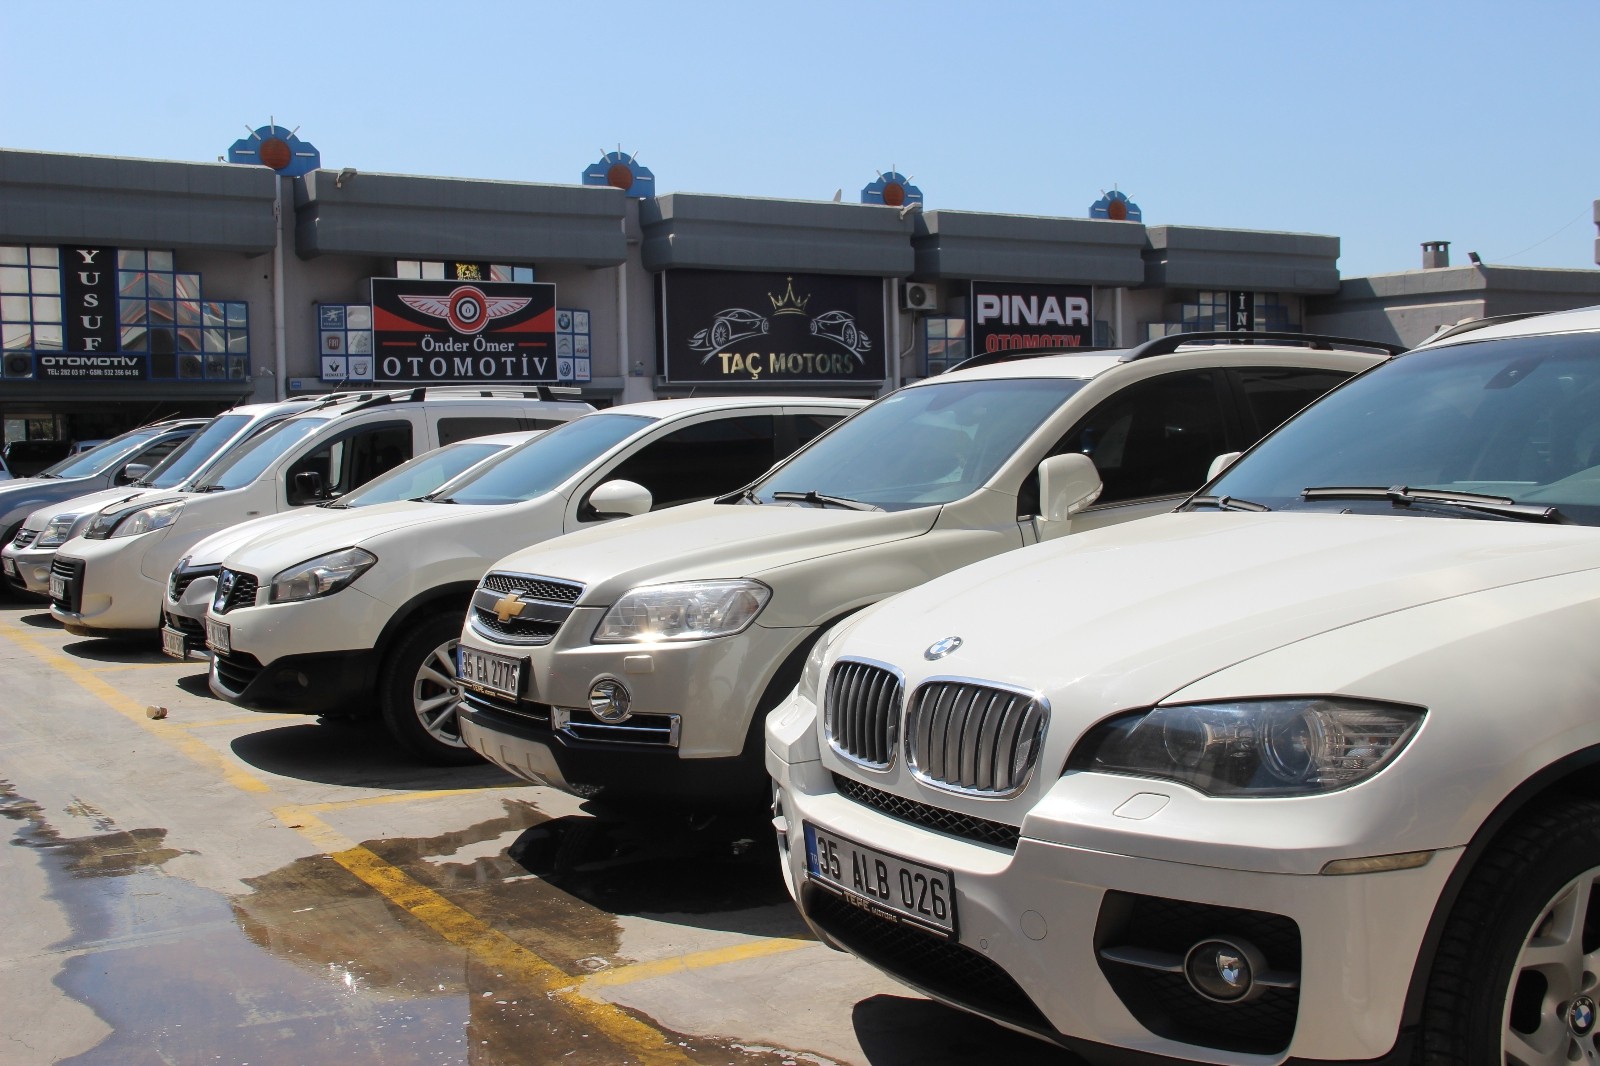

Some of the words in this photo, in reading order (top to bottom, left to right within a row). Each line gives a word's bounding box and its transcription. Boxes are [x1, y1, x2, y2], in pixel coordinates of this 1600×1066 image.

[76, 249, 103, 351] YUSUF
[976, 294, 1089, 326] PINAR
[421, 334, 469, 352] Önder
[473, 334, 515, 352] Ömer
[41, 356, 138, 366] OTOMOTİV
[383, 353, 548, 377] OTOMOTİV
[718, 353, 762, 380] TAÇ
[770, 353, 854, 374] MOTORS
[462, 651, 473, 678] 35
[817, 836, 841, 880] 35
[852, 850, 890, 900] ALB
[899, 867, 947, 921] 026
